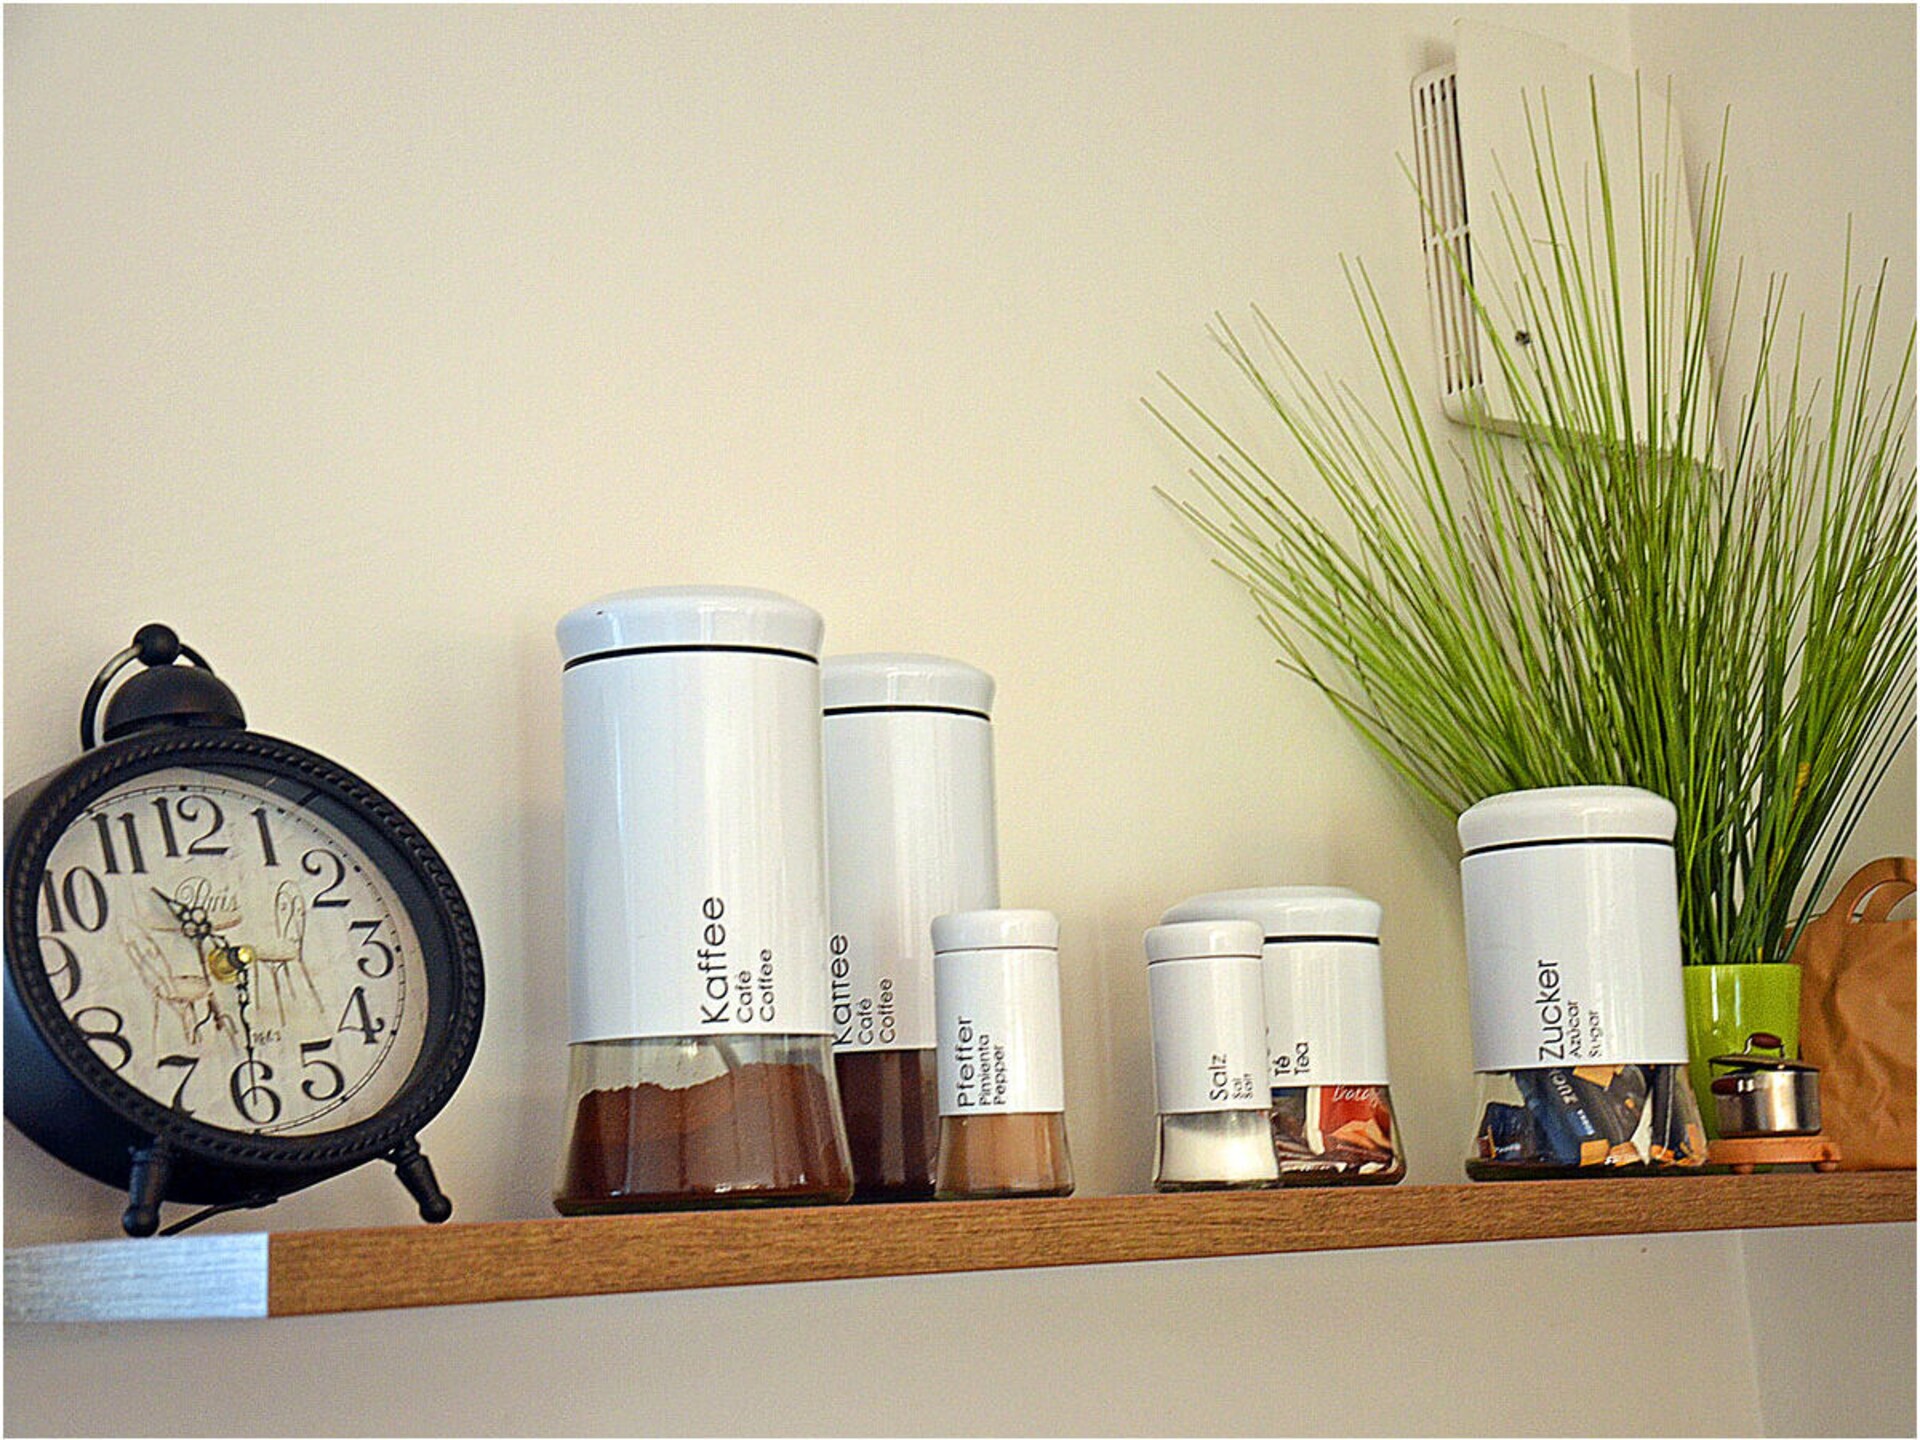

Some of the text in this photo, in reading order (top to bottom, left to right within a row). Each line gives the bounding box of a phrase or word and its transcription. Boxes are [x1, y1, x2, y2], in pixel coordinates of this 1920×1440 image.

[91, 812, 149, 874] 11
[152, 795, 231, 858] 12
[251, 807, 279, 867] 1
[43, 865, 109, 933] 10
[301, 849, 351, 908] 2
[38, 935, 82, 1001] 9
[349, 919, 395, 979] 3
[697, 896, 730, 1023] Kaffee
[338, 984, 385, 1045] 4
[734, 970, 753, 1023] Café
[757, 949, 775, 1022] Coffee
[877, 978, 896, 1043] Coffee
[1535, 959, 1566, 1061] Zucker
[71, 1006, 132, 1071] 8
[856, 998, 874, 1045] Café
[157, 1054, 200, 1118] 7
[300, 1037, 345, 1101] 5
[955, 1015, 975, 1107] Pfeffer
[978, 1034, 992, 1106] Pimienta
[993, 1045, 1007, 1105] Pepper
[1207, 1054, 1229, 1101] Salz
[1294, 1042, 1310, 1076] Tea
[230, 1060, 282, 1124] 6
